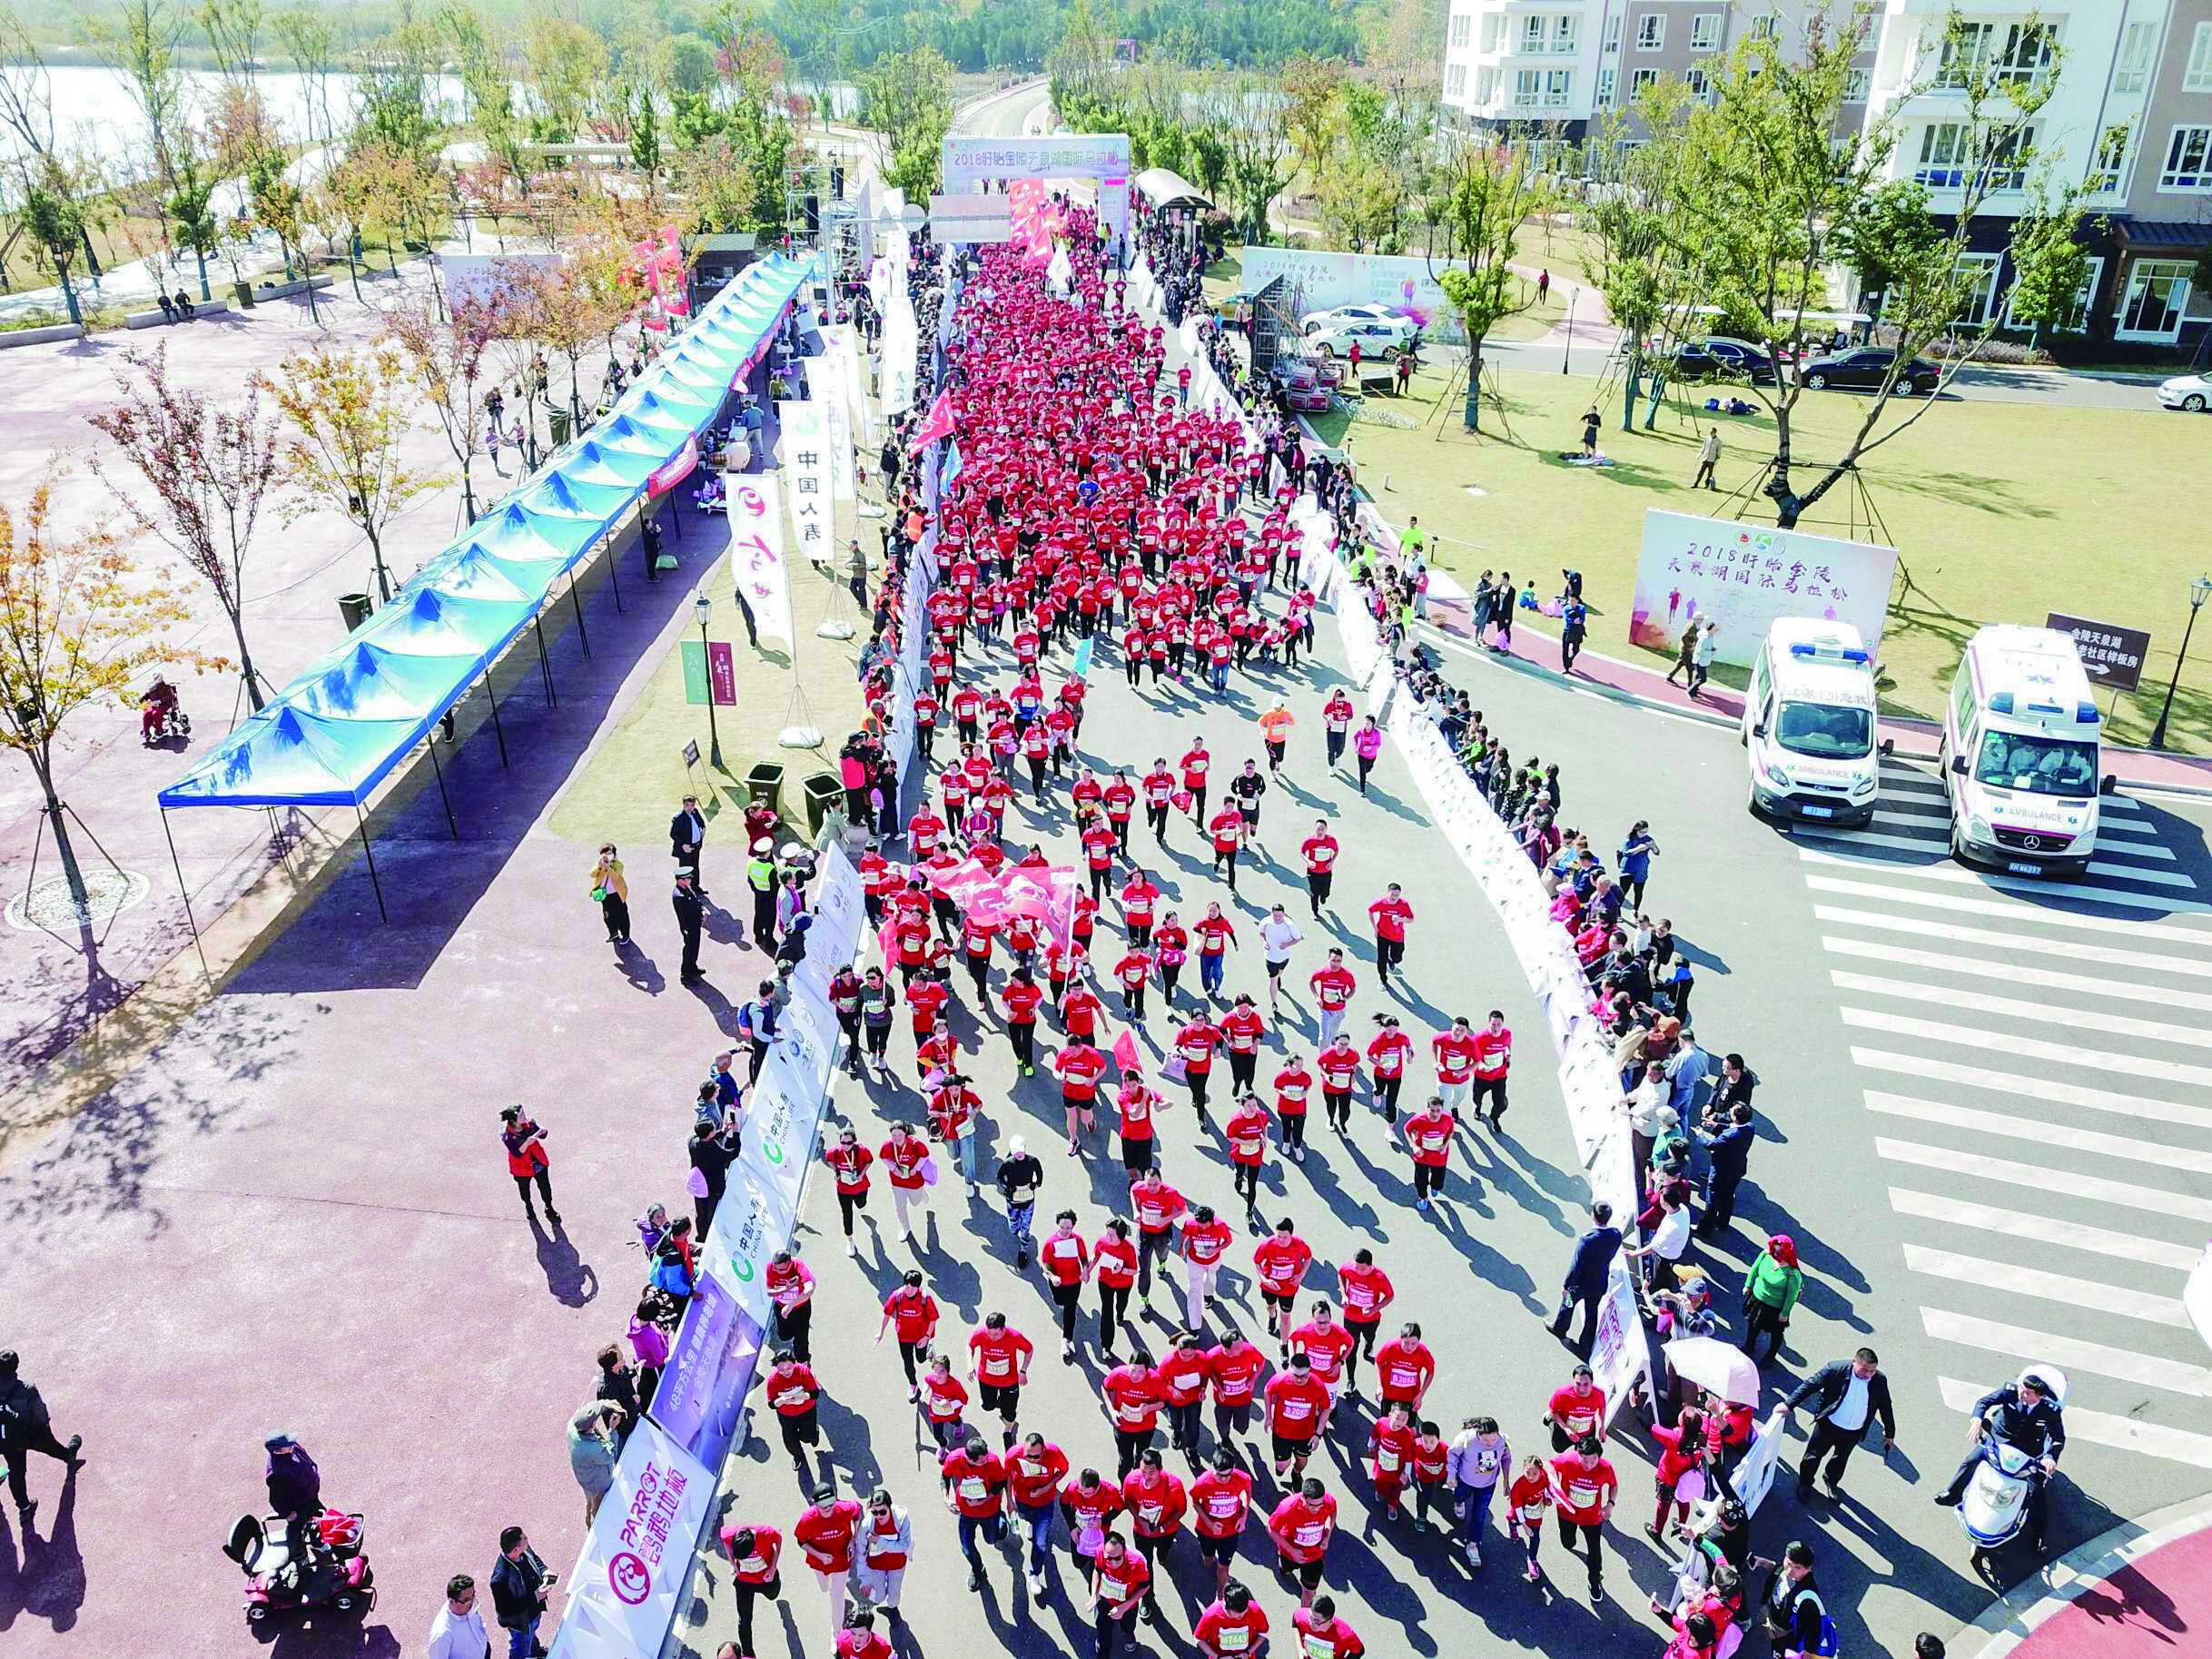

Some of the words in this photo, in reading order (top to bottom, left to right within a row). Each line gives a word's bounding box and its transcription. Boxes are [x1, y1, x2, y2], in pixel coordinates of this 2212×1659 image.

[1686, 542, 1832, 583] 2018盱眙金陵
[2071, 627, 2122, 649] 金陵天泉湖
[2008, 806, 2062, 822] AMBULANCE
[771, 1090, 790, 1136] 中国人寿
[739, 1197, 763, 1251] 中国人寿
[750, 1229, 764, 1259] CHINA
[760, 1207, 770, 1229] LIFE
[620, 1462, 661, 1547] PARROT
[638, 1466, 687, 1566] 鹦鹉地板
